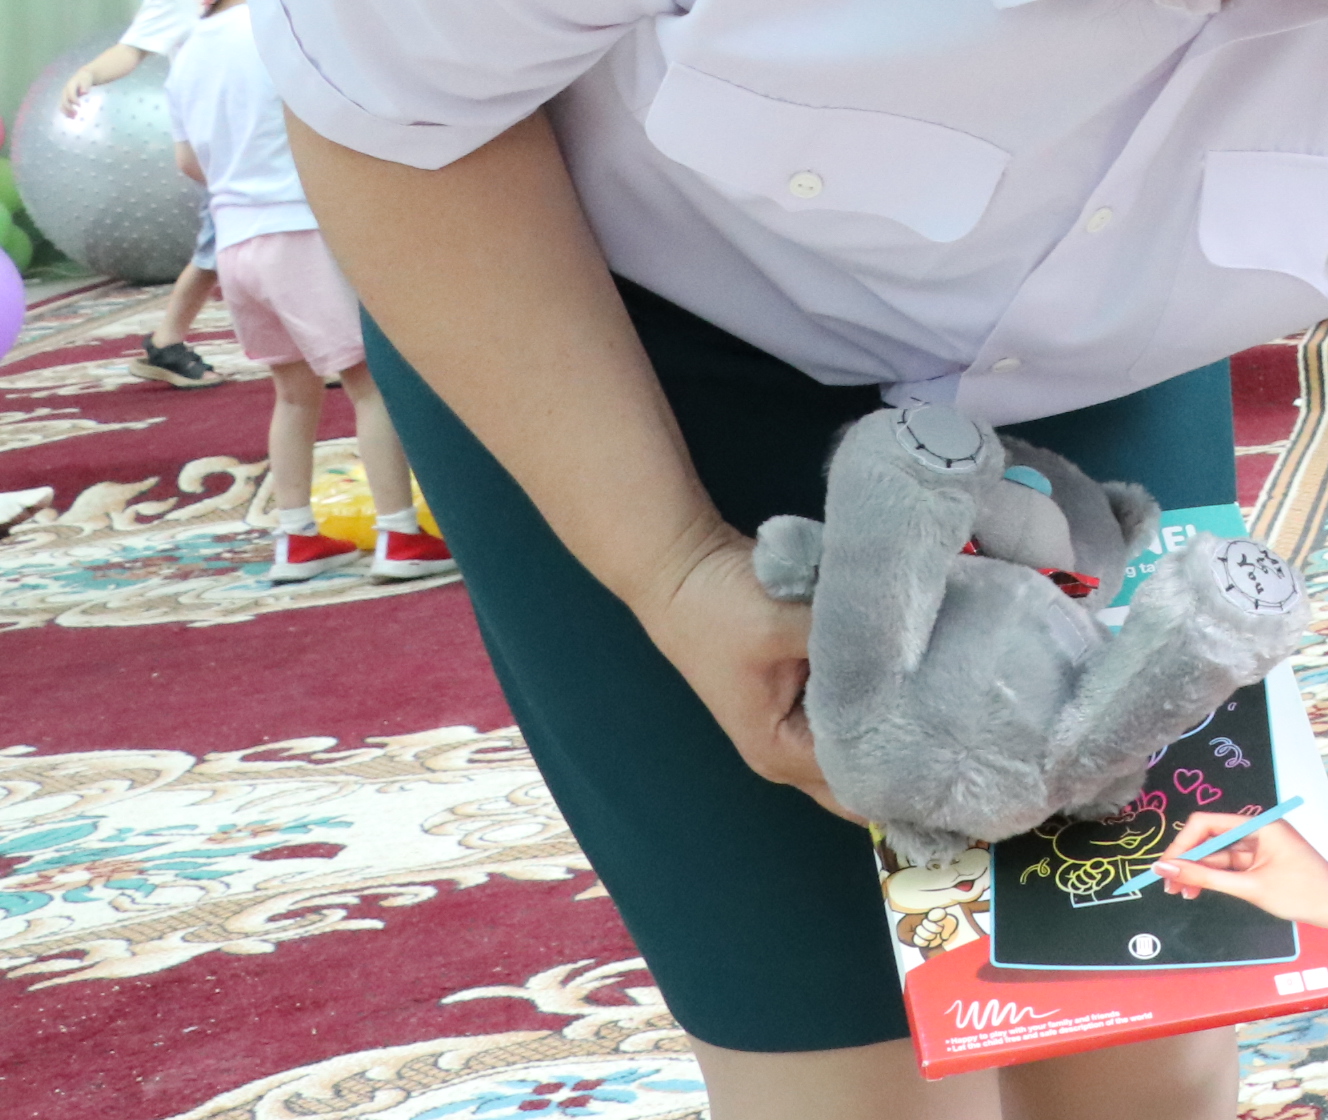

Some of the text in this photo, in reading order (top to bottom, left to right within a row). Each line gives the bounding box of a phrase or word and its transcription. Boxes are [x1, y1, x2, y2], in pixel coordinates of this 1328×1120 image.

[950, 1035, 978, 1045] Happy
[989, 1030, 1007, 1040] play
[1008, 1026, 1026, 1034] with
[1027, 1023, 1047, 1034] your
[1048, 1018, 1073, 1028] family
[1074, 1015, 1090, 1024] and
[1091, 1010, 1121, 1020] friends
[982, 1038, 1003, 1047] child
[1005, 1035, 1021, 1043] free
[1022, 1032, 1038, 1040] and
[1039, 1028, 1057, 1038] safe
[1058, 1020, 1105, 1034] description
[1105, 1018, 1115, 1026] of
[1115, 1016, 1128, 1024] the
[1129, 1011, 1153, 1022] world
